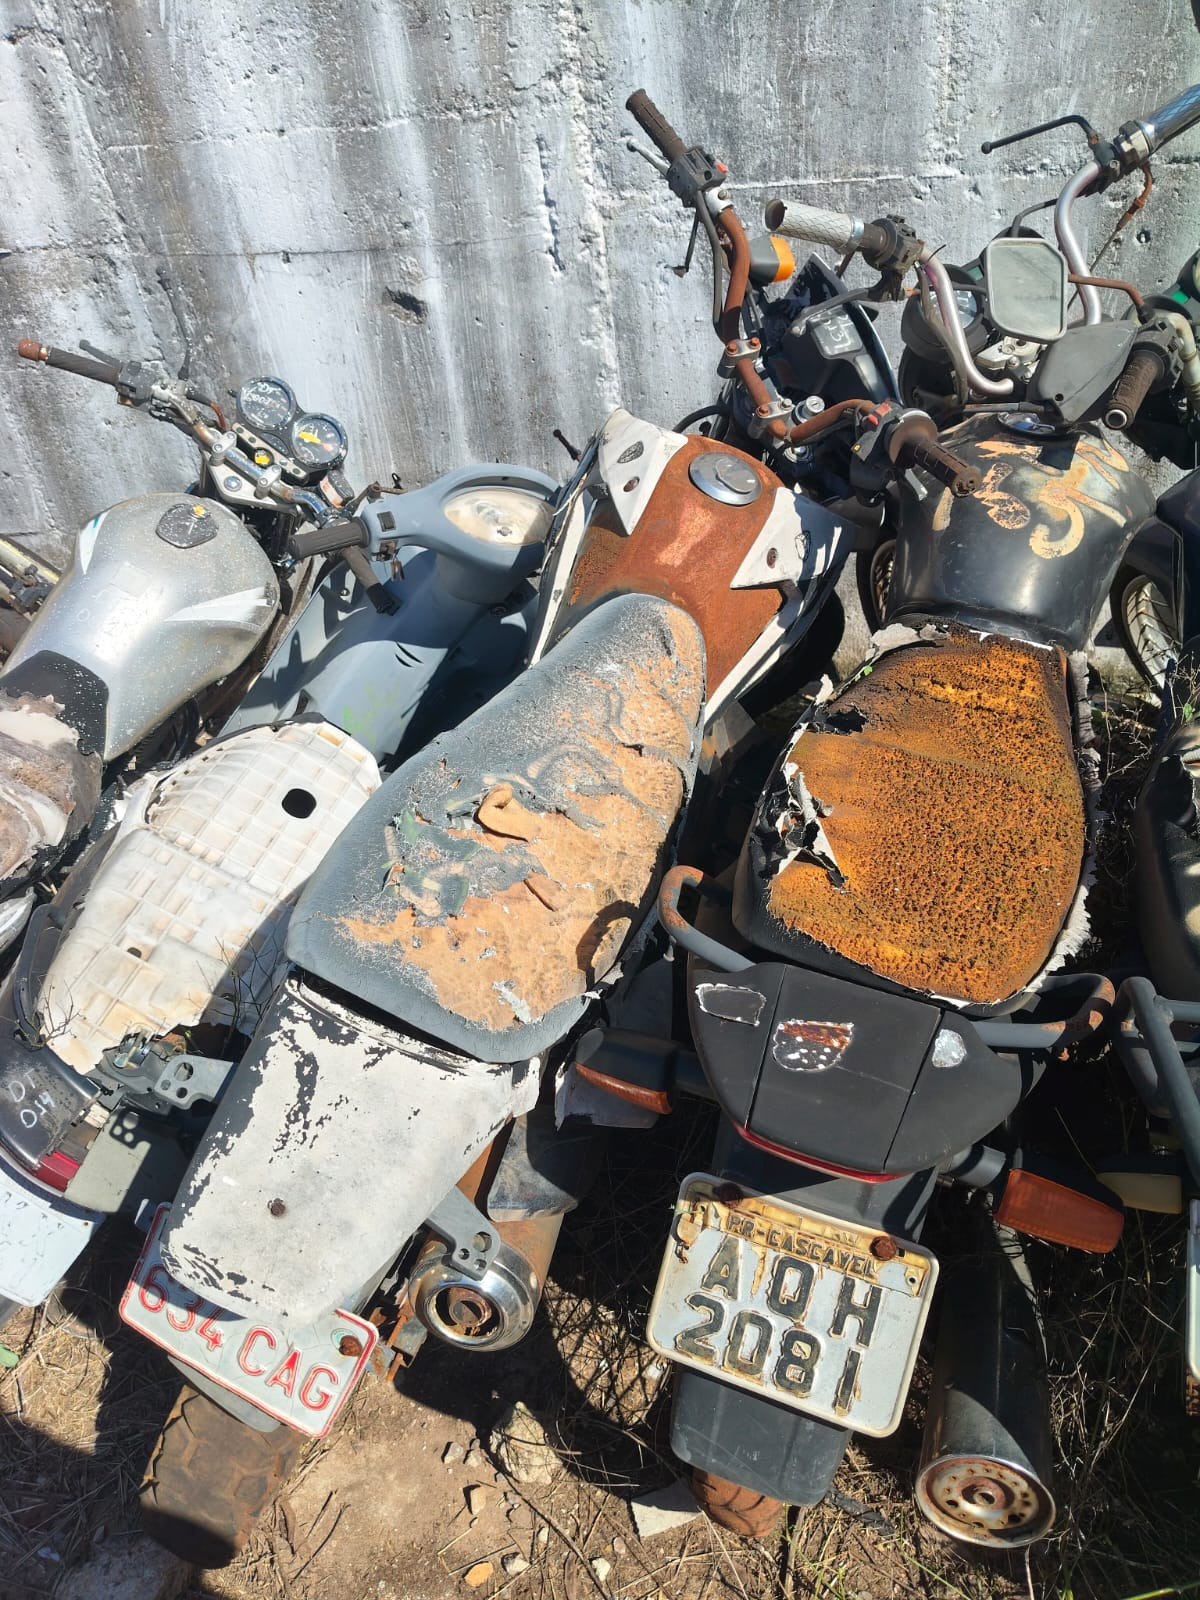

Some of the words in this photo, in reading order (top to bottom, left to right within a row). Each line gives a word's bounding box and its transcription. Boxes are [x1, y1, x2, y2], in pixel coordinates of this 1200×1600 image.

[726, 1211, 879, 1278] PR-CASCAVEL
[238, 1326, 339, 1410] CAG
[675, 1291, 861, 1416] 2081
